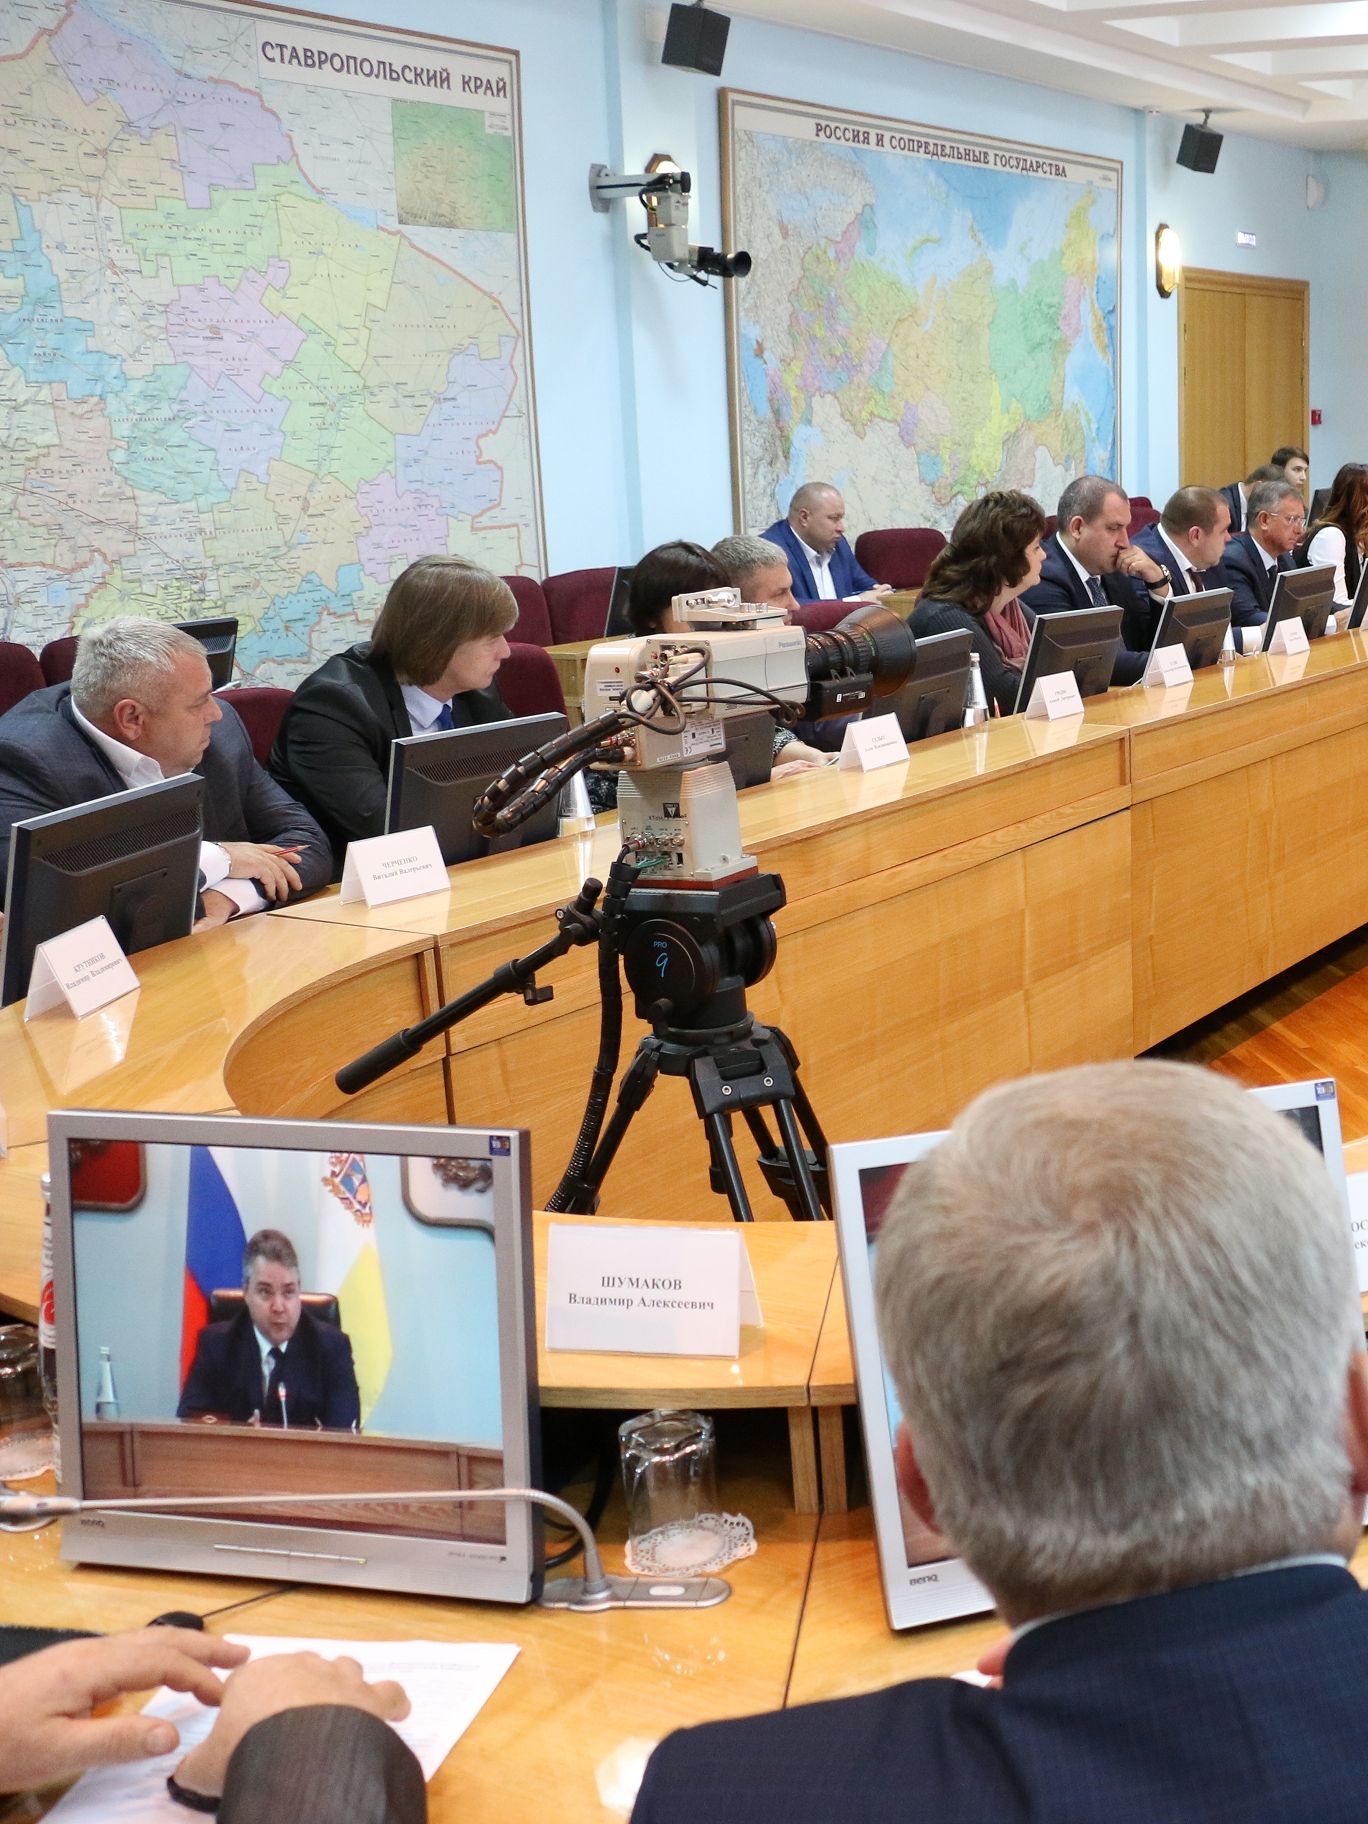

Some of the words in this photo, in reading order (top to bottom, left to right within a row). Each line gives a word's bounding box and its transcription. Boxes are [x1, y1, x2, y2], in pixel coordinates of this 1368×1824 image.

[261, 40, 451, 90] СТАВРОПОЛЬСКИЙ
[461, 73, 508, 99] КРАЙ
[814, 122, 870, 145] РОССИЯ
[875, 134, 885, 147] И
[889, 135, 990, 165] СОПРЕДЕЛЬНЫЕ
[993, 153, 1068, 178] ГОСУДАРСТВА
[382, 856, 418, 869] ЧЕРЧЕНКО
[653, 941, 668, 949] PRO
[600, 1275, 683, 1291] ШУМАКОВ
[568, 1292, 634, 1310] Владимир
[637, 1297, 715, 1311] Алексеевич
